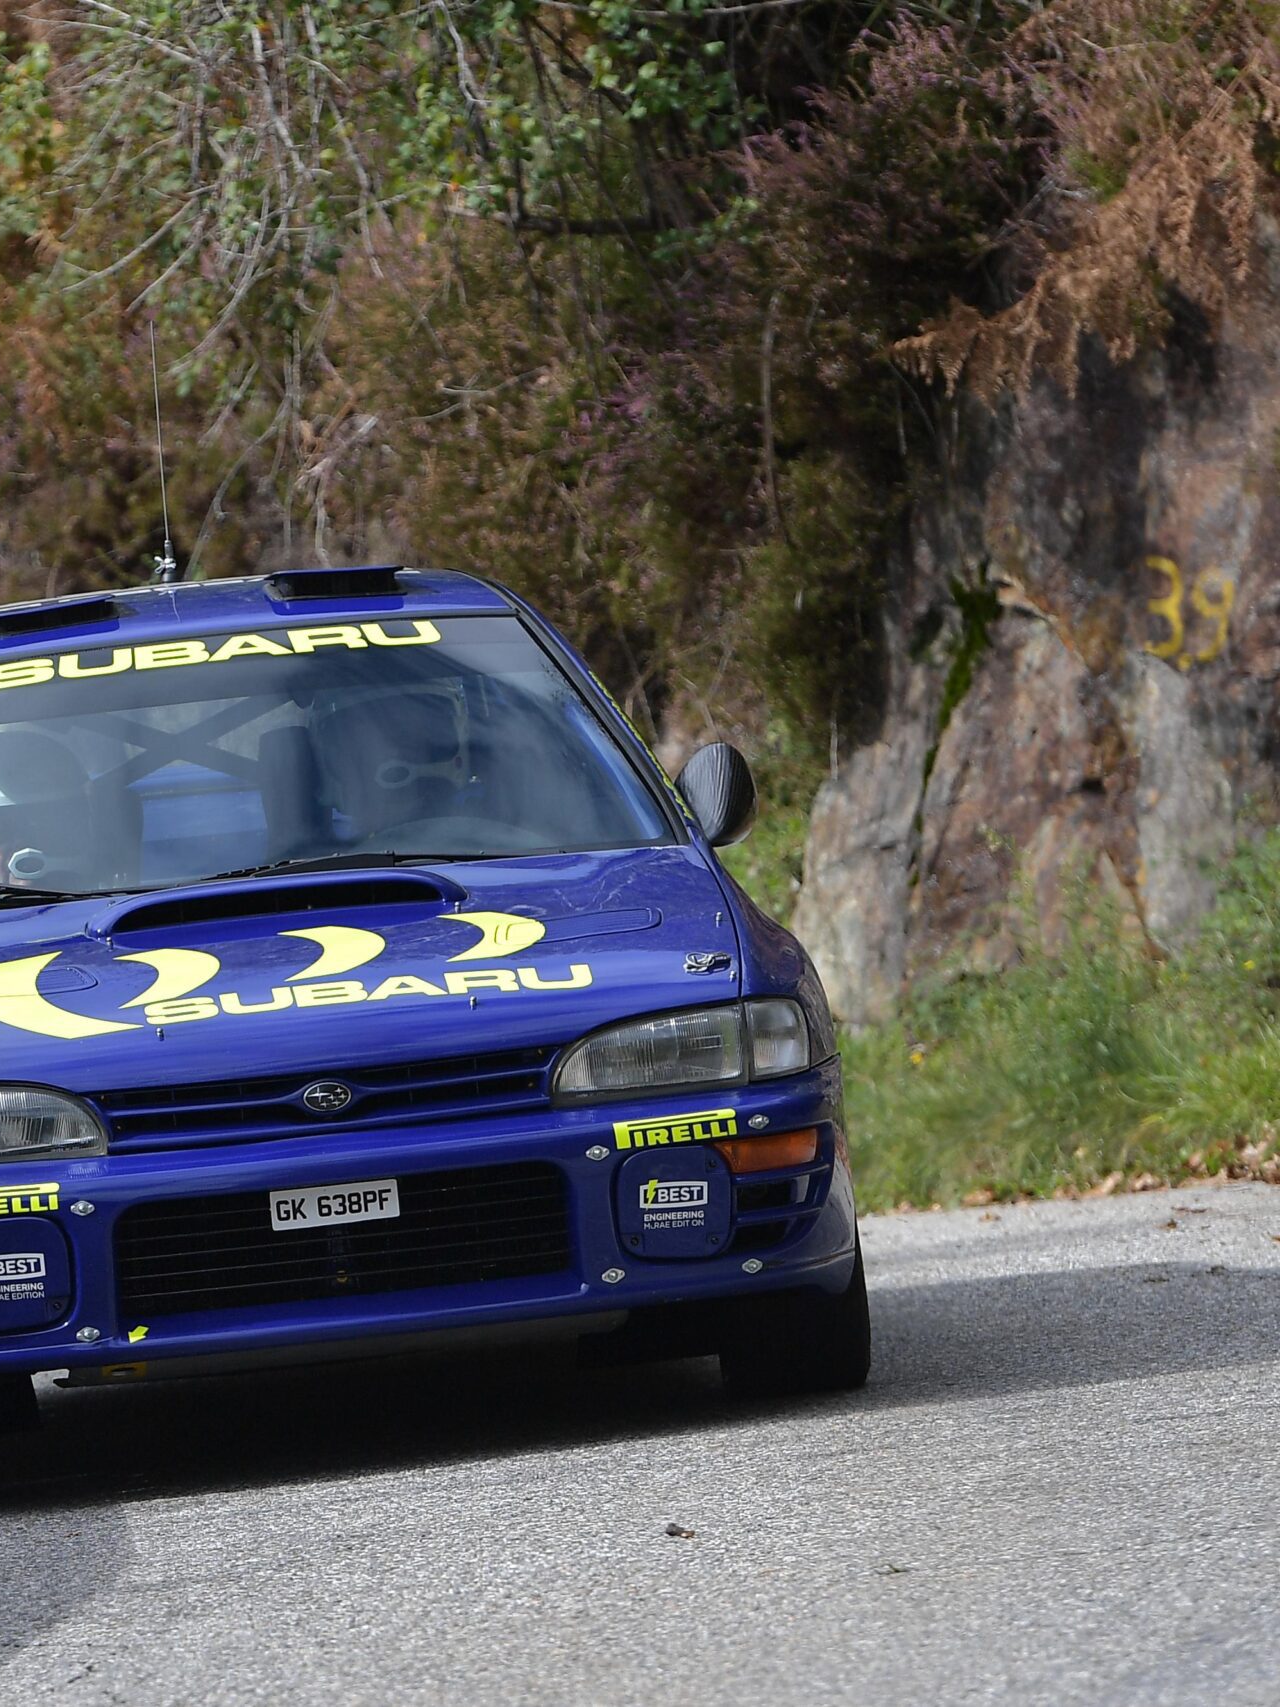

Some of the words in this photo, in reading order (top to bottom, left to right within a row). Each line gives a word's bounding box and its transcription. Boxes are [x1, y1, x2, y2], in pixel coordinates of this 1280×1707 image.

[144, 963, 594, 1026] SUBARU
[613, 1108, 738, 1150] PIRELLI
[657, 1186, 701, 1203] BEST
[275, 1198, 307, 1222] GK
[317, 1188, 392, 1218] 638PF
[643, 1210, 705, 1222] ENGINEERING
[671, 1219, 705, 1229] EDITON
[11, 1290, 46, 1301] EDITION
